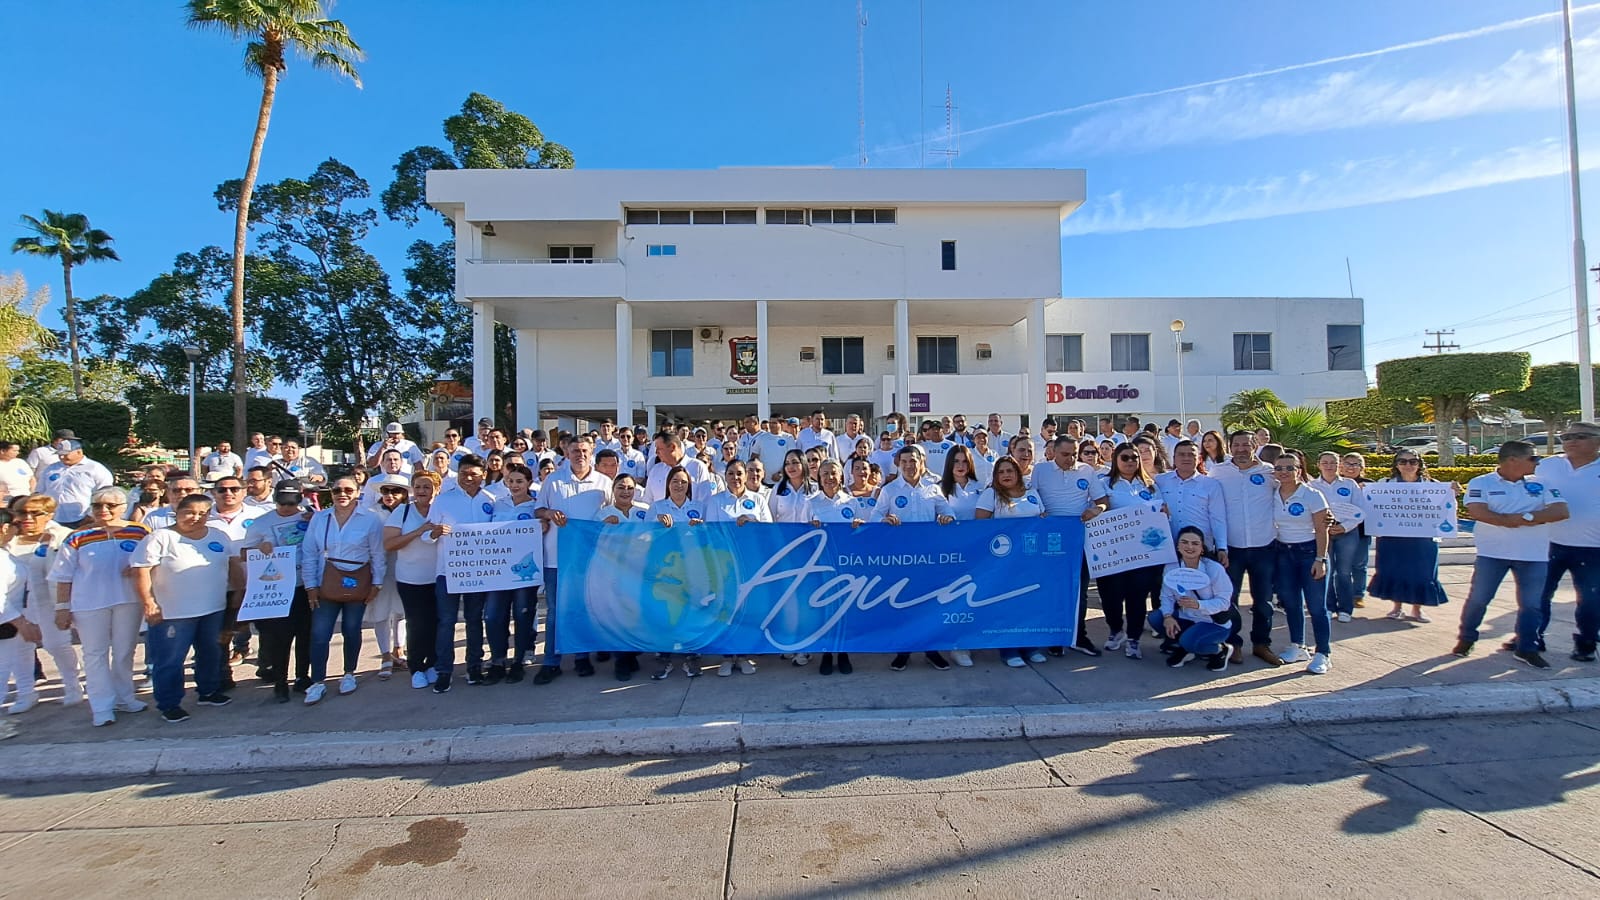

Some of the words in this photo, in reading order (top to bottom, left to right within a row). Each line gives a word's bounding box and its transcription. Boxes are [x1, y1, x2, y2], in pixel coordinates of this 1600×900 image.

[1065, 384, 1140, 403] BanBajío
[1085, 513, 1128, 529] CUIDEMOS
[450, 529, 482, 538] TOMAR
[486, 528, 512, 536] AGUA
[1088, 528, 1111, 538] AGUA
[1114, 519, 1141, 531] TODOS
[1091, 541, 1107, 550] LOS
[1110, 533, 1135, 545] SERES
[479, 547, 512, 555] TOMAR
[448, 558, 507, 568] CONCIENCIA
[838, 553, 864, 566] DÍA
[868, 554, 935, 566] MUNDIAL
[939, 553, 966, 564] DEL
[1091, 553, 1150, 572] NECESITAMOS
[459, 579, 485, 587] AGUA
[253, 591, 284, 600] ESTOY
[726, 529, 1041, 652] Agua
[242, 599, 289, 609] ACABANDO
[943, 612, 975, 625] 2025
